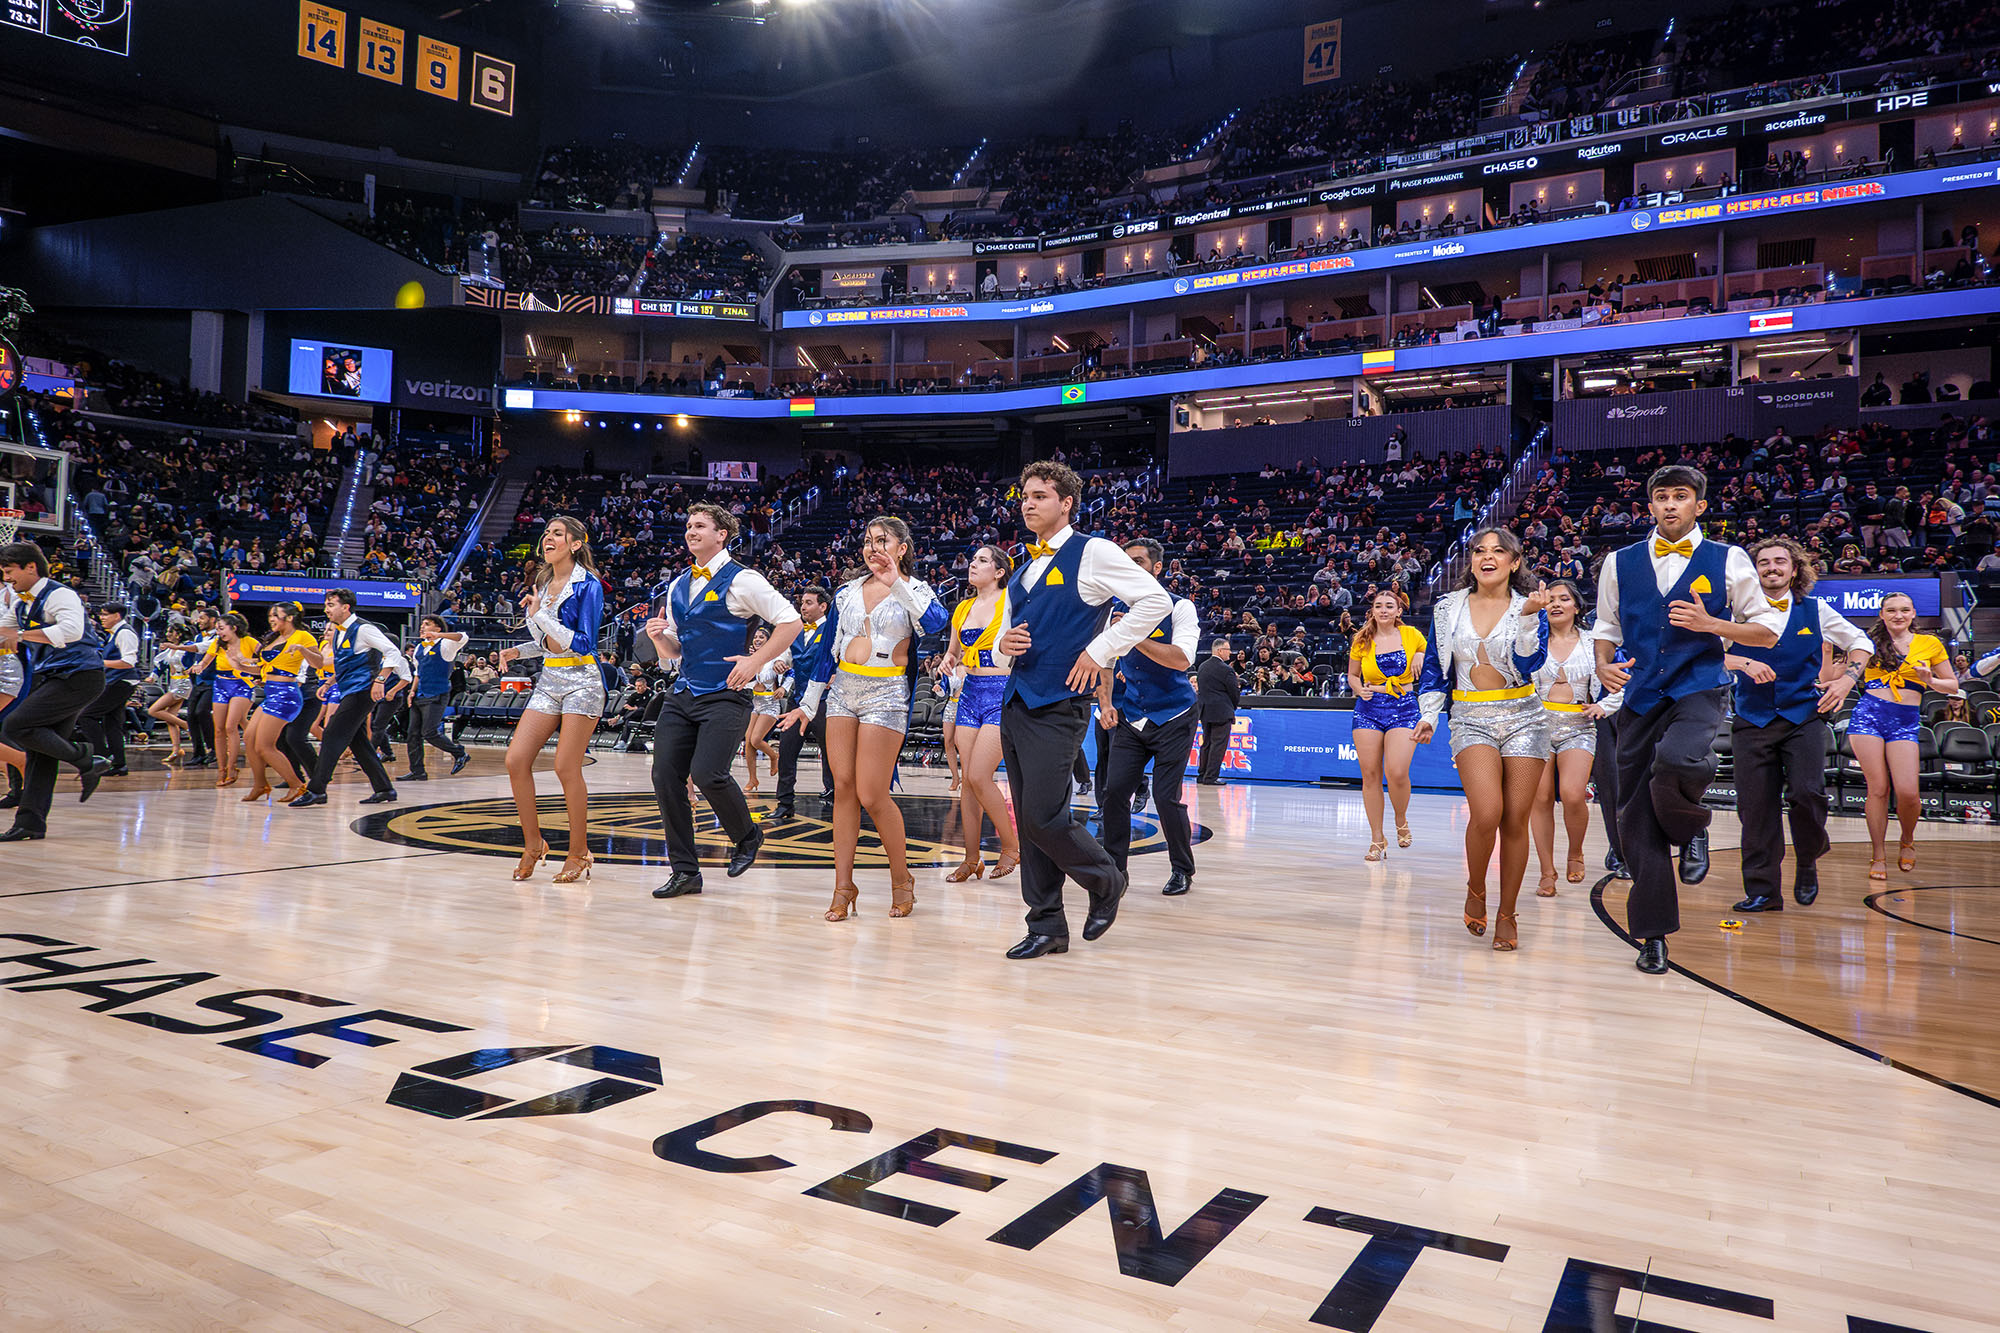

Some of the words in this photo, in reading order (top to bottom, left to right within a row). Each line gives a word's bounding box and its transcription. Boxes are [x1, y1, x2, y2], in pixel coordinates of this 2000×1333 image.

[9, 9, 39, 25] 73.7%
[306, 23, 337, 59] 14
[366, 41, 396, 75] 13
[1308, 41, 1338, 70] 47
[429, 60, 447, 90] 9
[481, 67, 505, 102] 6
[1876, 91, 1929, 113] HPE
[1765, 111, 1826, 132] accenture
[1661, 126, 1728, 145] ORACLE
[1578, 144, 1621, 159] Rakuten
[1483, 159, 1525, 175] CHASE
[1402, 179, 1422, 188] KAISER
[1423, 172, 1464, 185] PERMANENTE
[1943, 172, 1983, 183] PRESENTED
[1983, 170, 1994, 178] BY
[1320, 188, 1350, 202] Google
[1351, 184, 1376, 196] Cloud
[1726, 190, 1819, 214] HERITAGE
[1822, 181, 1885, 201] NIGHT
[1238, 204, 1265, 213] UNITED
[1274, 196, 1308, 208] AIRLINES
[1174, 208, 1231, 226] RingCentral
[1127, 221, 1158, 234] PEPSI
[1014, 242, 1036, 250] CENTER
[1045, 237, 1071, 247] FOUNDING
[1071, 232, 1098, 243] PARTNERS
[1395, 250, 1423, 258] PRESENTED
[1432, 242, 1465, 257] Modelo
[1242, 263, 1308, 282] HERITAGE
[1309, 256, 1355, 272] NIGHT
[641, 303, 658, 311] CHI
[659, 303, 673, 313] 137
[682, 305, 698, 313] PHI
[700, 304, 714, 315] 157
[722, 307, 749, 316] FINAL
[870, 309, 929, 320] HERITAGE
[929, 306, 969, 318] NIGHT
[1030, 300, 1054, 314] Modelo
[406, 379, 493, 403] verizon
[1726, 387, 1744, 397] 104
[1776, 391, 1834, 402] DOORDASH
[1625, 404, 1668, 420] Sports
[1347, 418, 1362, 427] 103
[383, 590, 406, 600] Modelo
[1826, 595, 1838, 603] BY
[1284, 745, 1324, 753] PRESENTED
[1325, 746, 1335, 754] BY
[1705, 788, 1728, 796] HASE
[1949, 799, 1983, 807] CHASE
